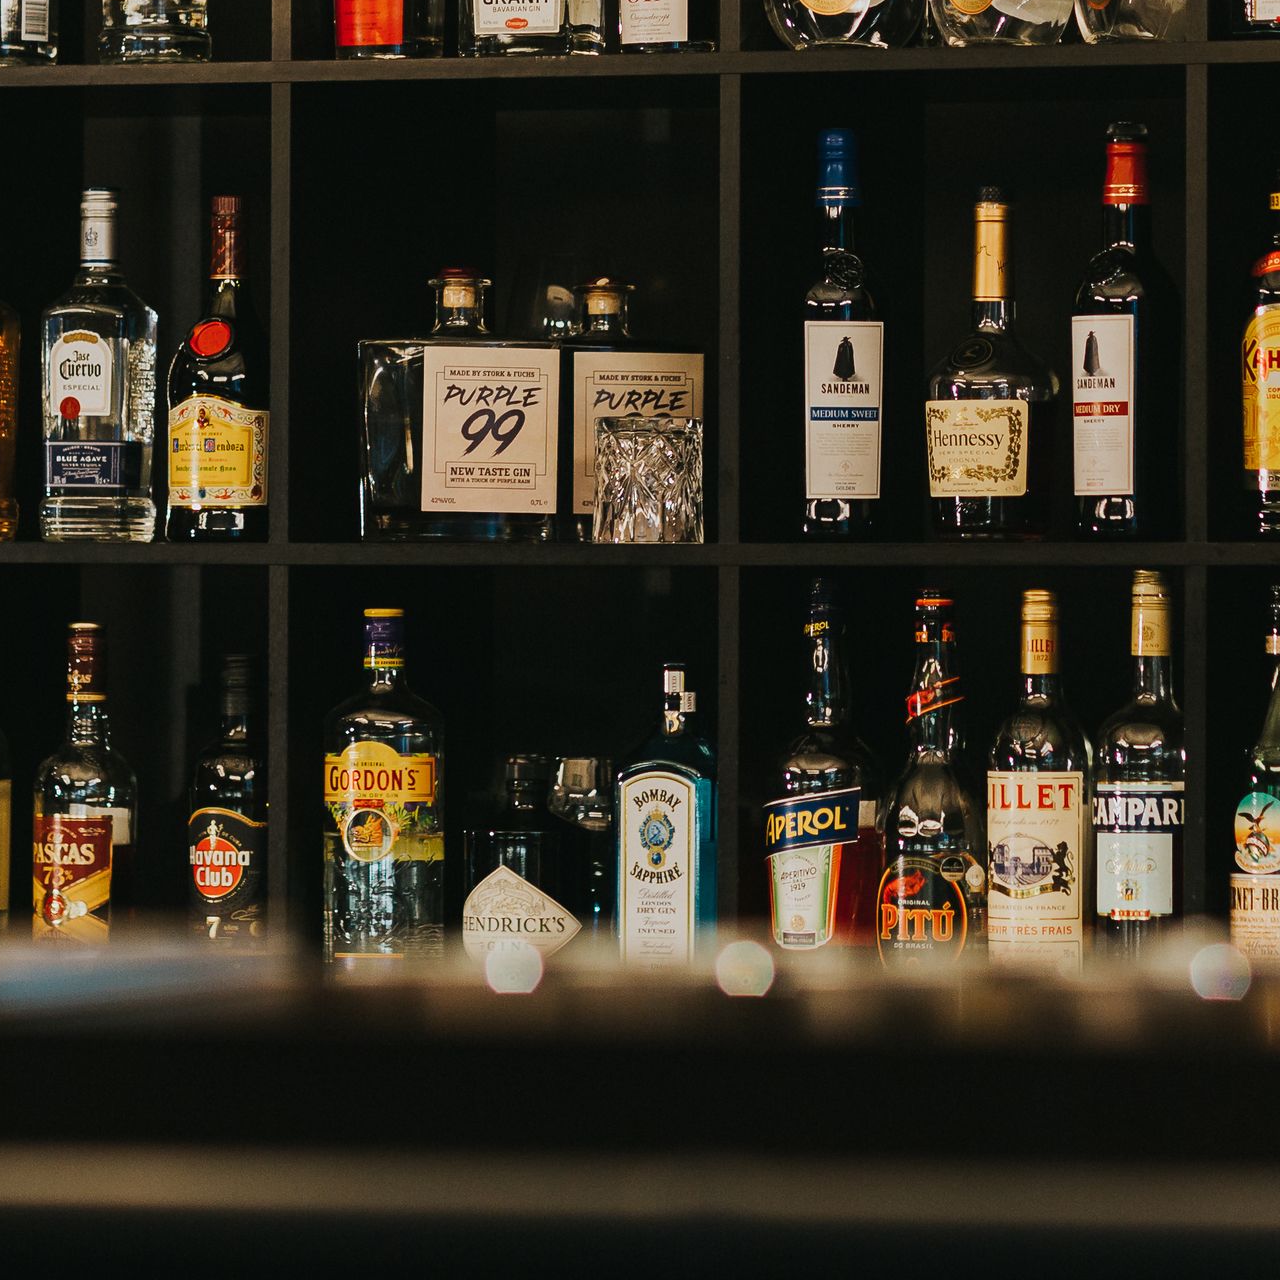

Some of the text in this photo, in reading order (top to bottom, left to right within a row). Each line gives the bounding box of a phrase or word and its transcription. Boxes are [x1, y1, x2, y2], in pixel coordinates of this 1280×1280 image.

[59, 358, 101, 380] Cuervo
[821, 383, 870, 394] SANDEMAN
[1077, 378, 1115, 389] SANDEMAN
[443, 384, 542, 407] PURPLE
[593, 389, 689, 412] PURPLE
[812, 409, 877, 418] MEDIUM SWEET
[1075, 404, 1120, 414] MEDIUM DRY
[458, 408, 525, 460] 99
[934, 430, 1004, 450] Hennessy
[450, 467, 531, 477] NEW TASTE GIN
[330, 766, 415, 791] GORDON'S
[633, 788, 682, 811] BOMBAY
[766, 806, 846, 846] APEROL
[33, 842, 95, 865] PASCAS
[189, 845, 250, 866] Havana
[43, 866, 73, 886] 73%
[196, 867, 233, 887] Club
[630, 861, 682, 884] SAPPHIRE
[780, 866, 817, 880] APERITIVO
[638, 888, 676, 899] Distilled
[790, 882, 806, 892] 1919
[206, 916, 221, 939] 7
[463, 915, 566, 933] HENDRICK'S
[881, 901, 954, 941] PITÚ
[1041, 925, 1073, 936] FRAIS
